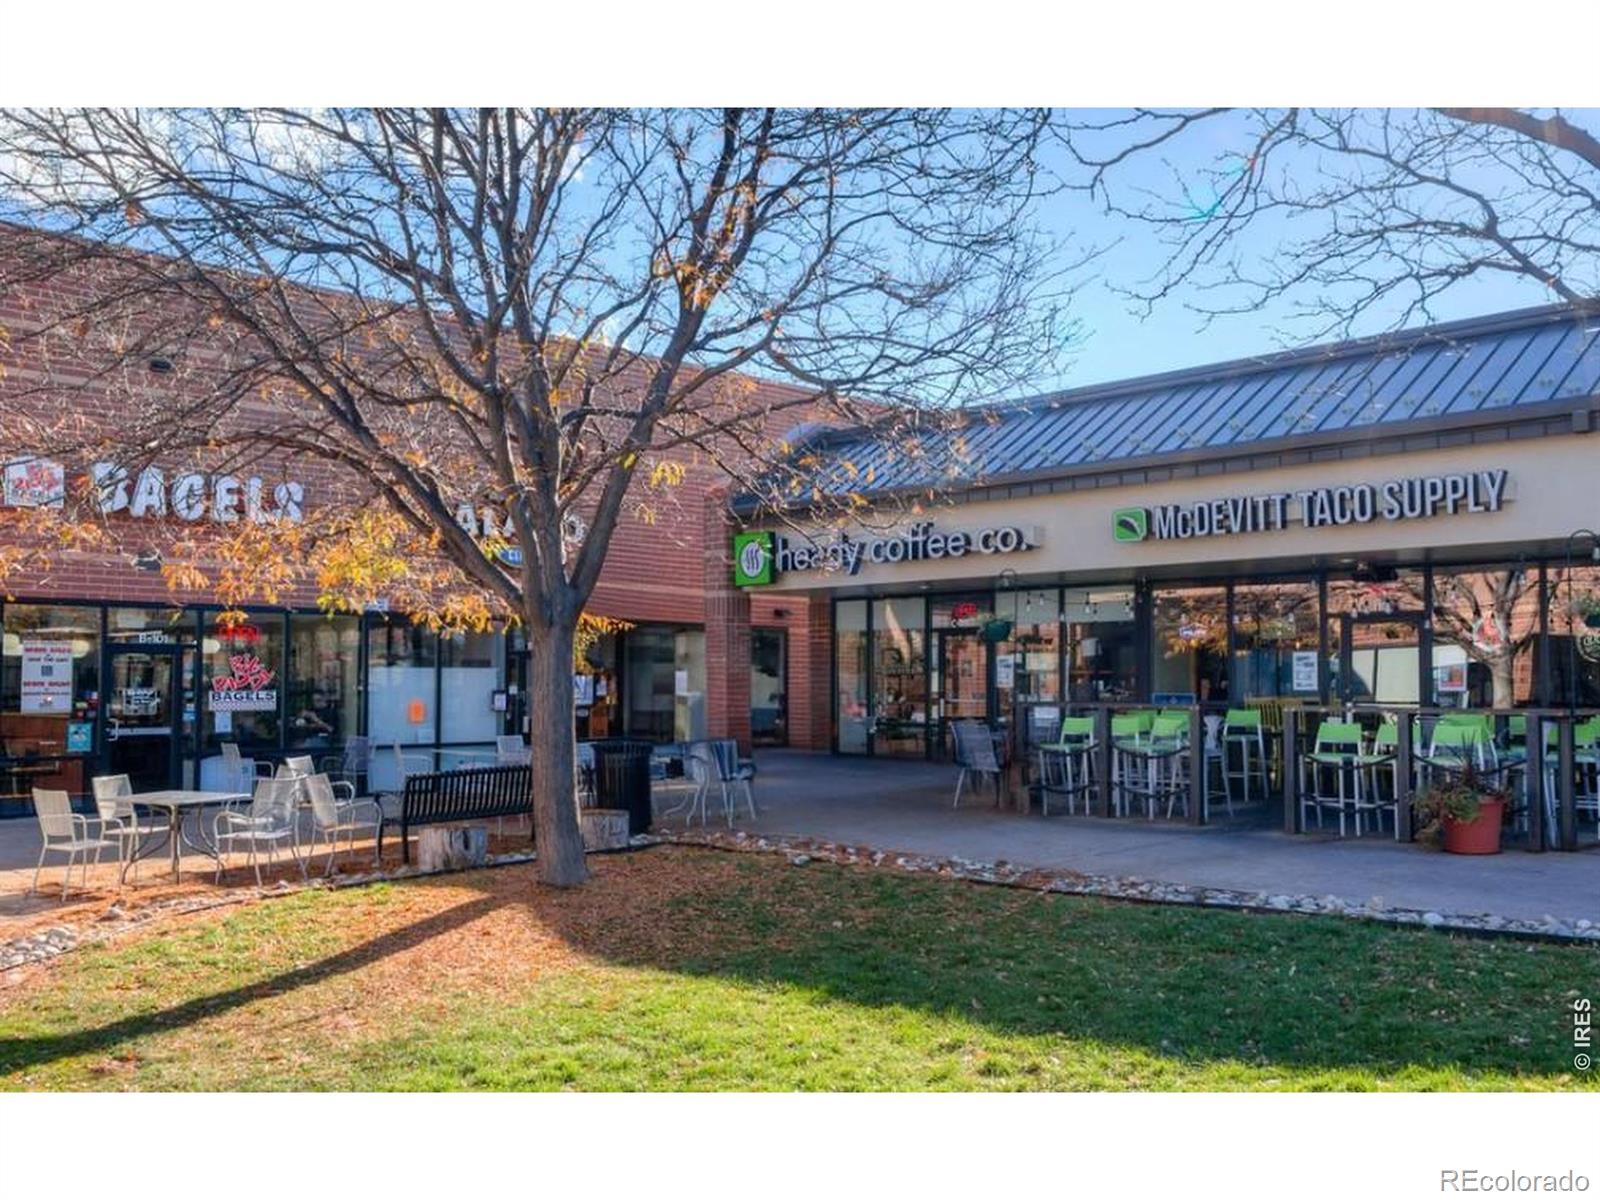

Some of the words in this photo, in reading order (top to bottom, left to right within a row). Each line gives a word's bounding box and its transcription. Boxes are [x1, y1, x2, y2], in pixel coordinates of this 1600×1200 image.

[1297, 483, 1377, 527] TACO
[1382, 469, 1508, 521] SUPPLY
[870, 521, 972, 563] coffee
[212, 690, 274, 701] BAGELS
